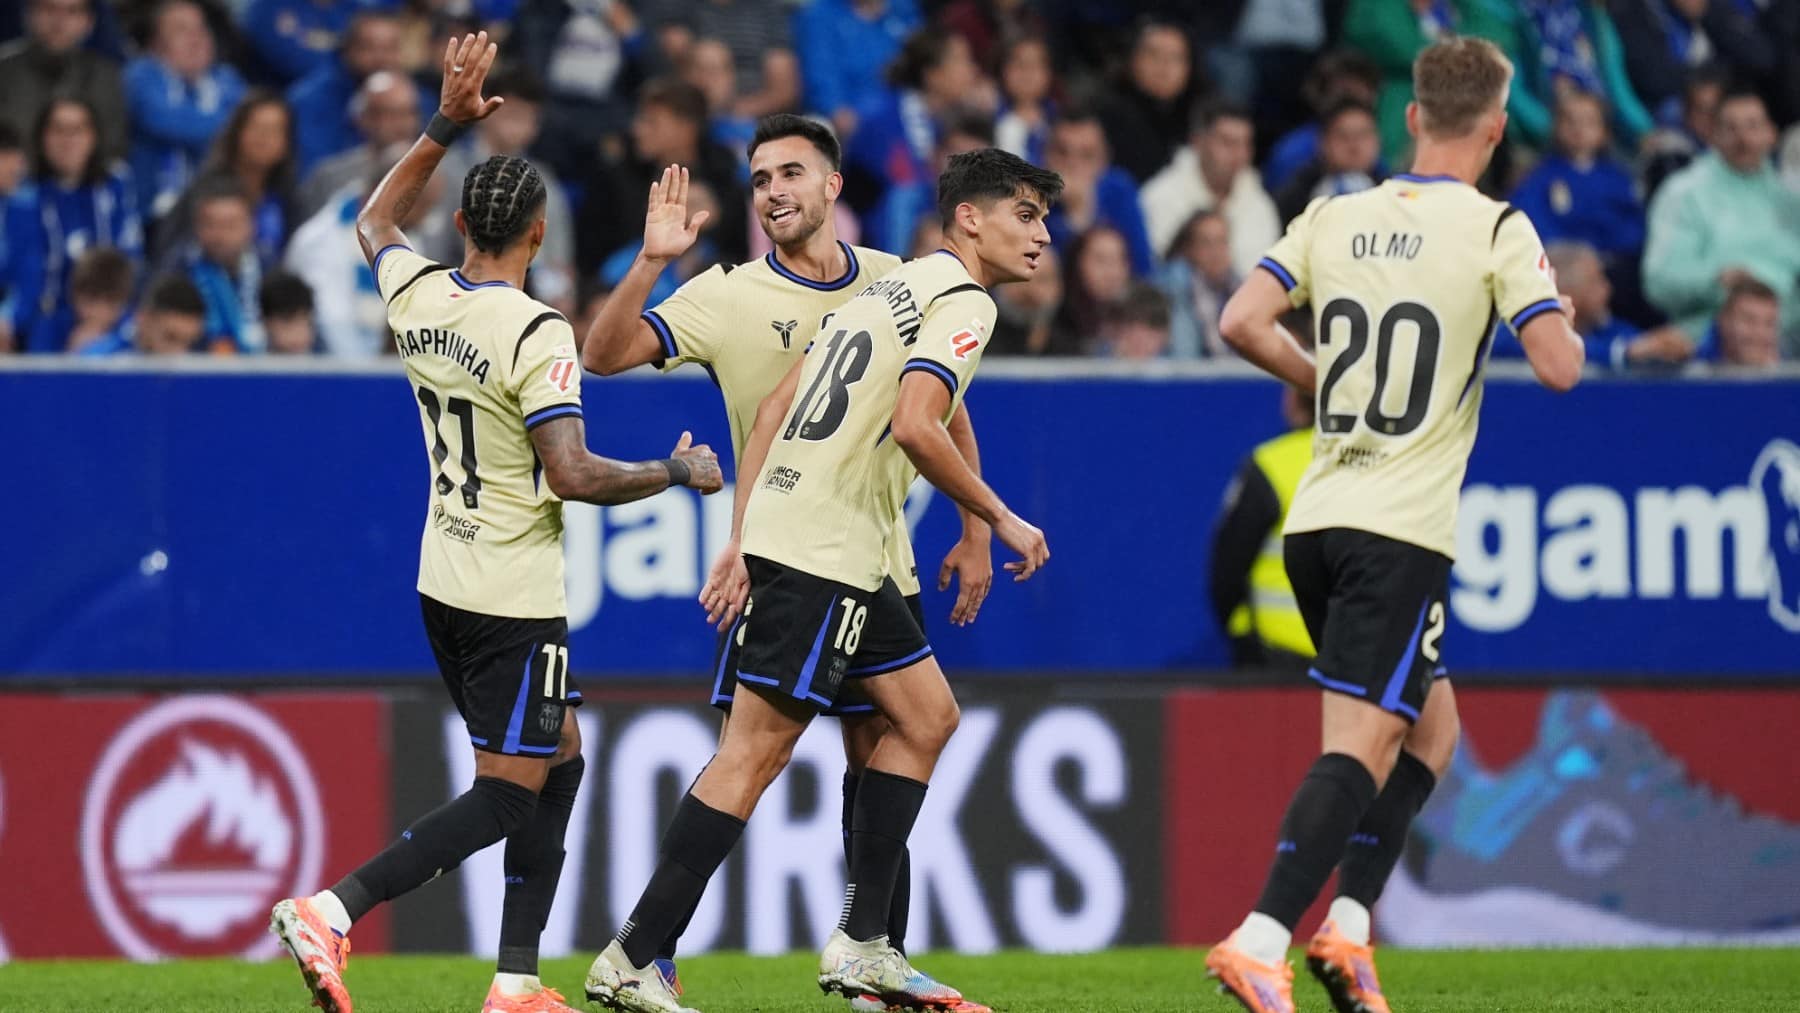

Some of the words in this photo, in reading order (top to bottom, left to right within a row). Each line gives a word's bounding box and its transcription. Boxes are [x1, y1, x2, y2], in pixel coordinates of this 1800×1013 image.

[1352, 232, 1423, 260] OLMO
[396, 328, 491, 385] RAPHINHA
[782, 329, 873, 441] 18
[1319, 297, 1441, 436] 20
[417, 385, 482, 510] 11
[834, 596, 868, 656] 18
[541, 643, 569, 700] 11
[440, 706, 1129, 956] WORKS
